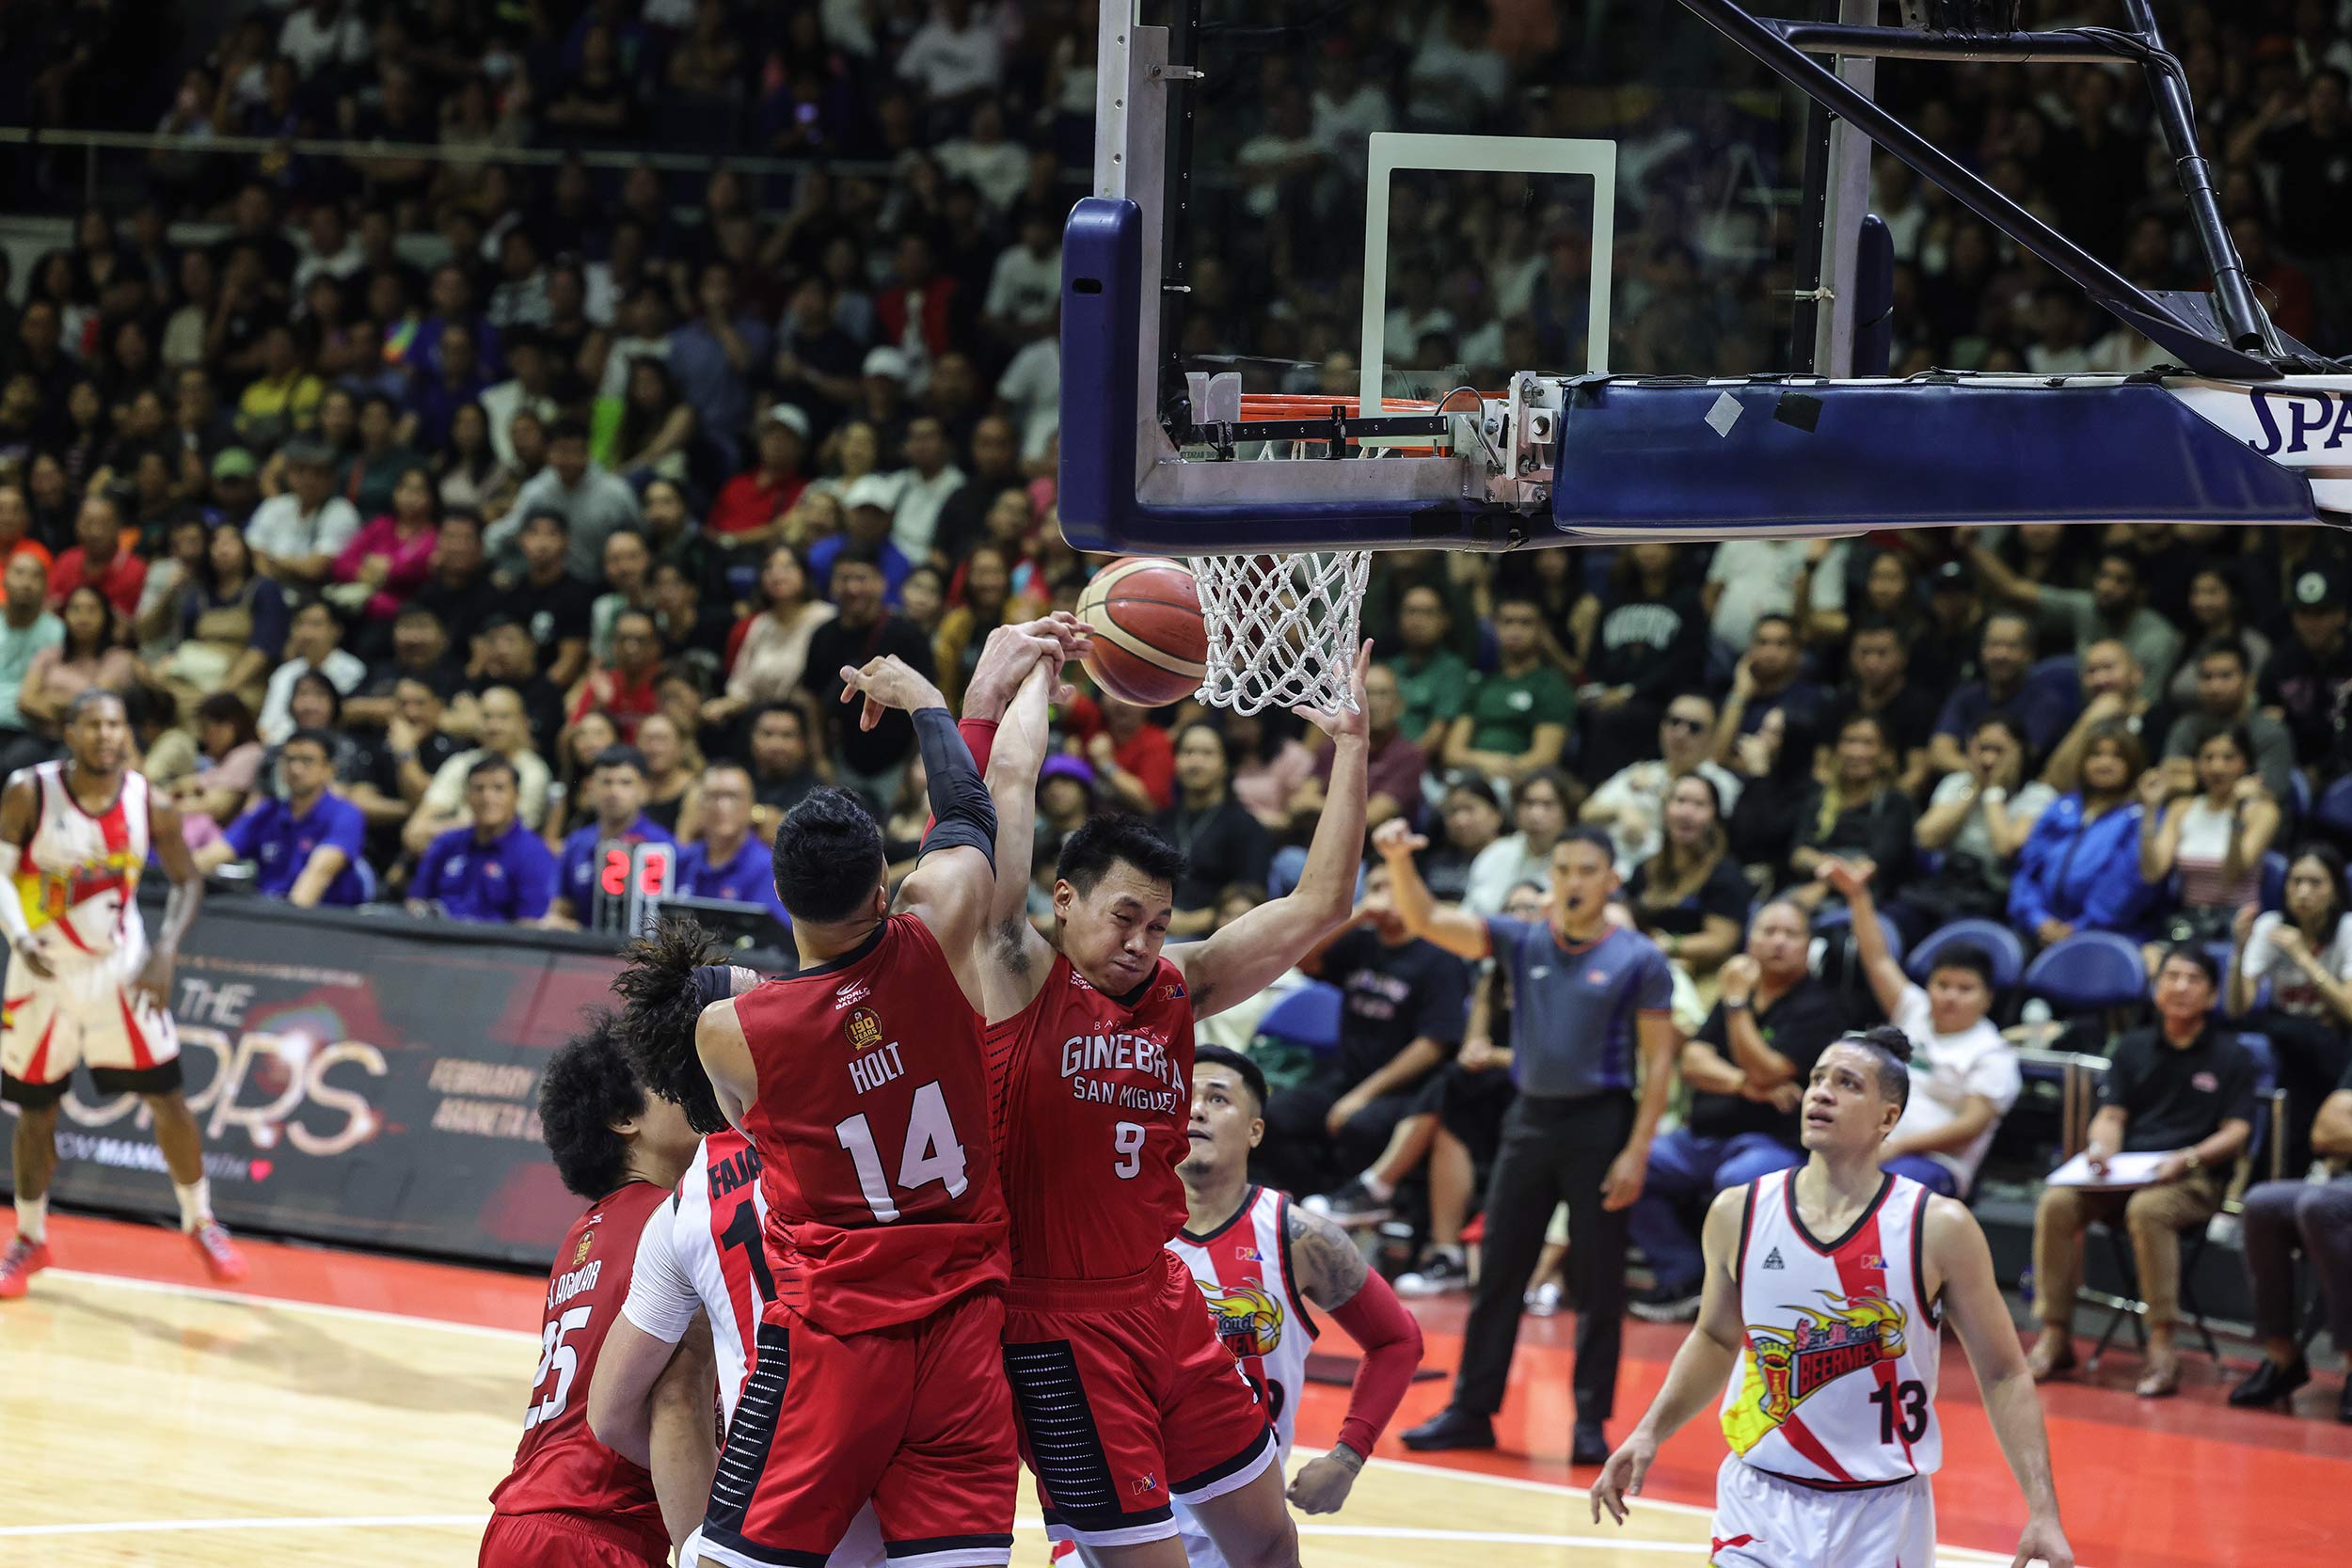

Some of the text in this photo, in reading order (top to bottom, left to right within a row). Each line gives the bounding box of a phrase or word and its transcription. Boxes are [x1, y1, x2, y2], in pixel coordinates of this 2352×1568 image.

[178, 976, 256, 1026] THE
[850, 1016, 876, 1036] 190
[853, 1026, 878, 1042] YEARS
[1093, 1019, 1168, 1044] BARGAY
[848, 1040, 906, 1096] HOLT
[1060, 1034, 1186, 1103] GINEBRA
[1073, 1075, 1178, 1116] SAN MIGUEL
[834, 1080, 970, 1225] 14
[1113, 1119, 1147, 1180] 9
[522, 1304, 594, 1432] 25
[1867, 1379, 1928, 1445] 13
